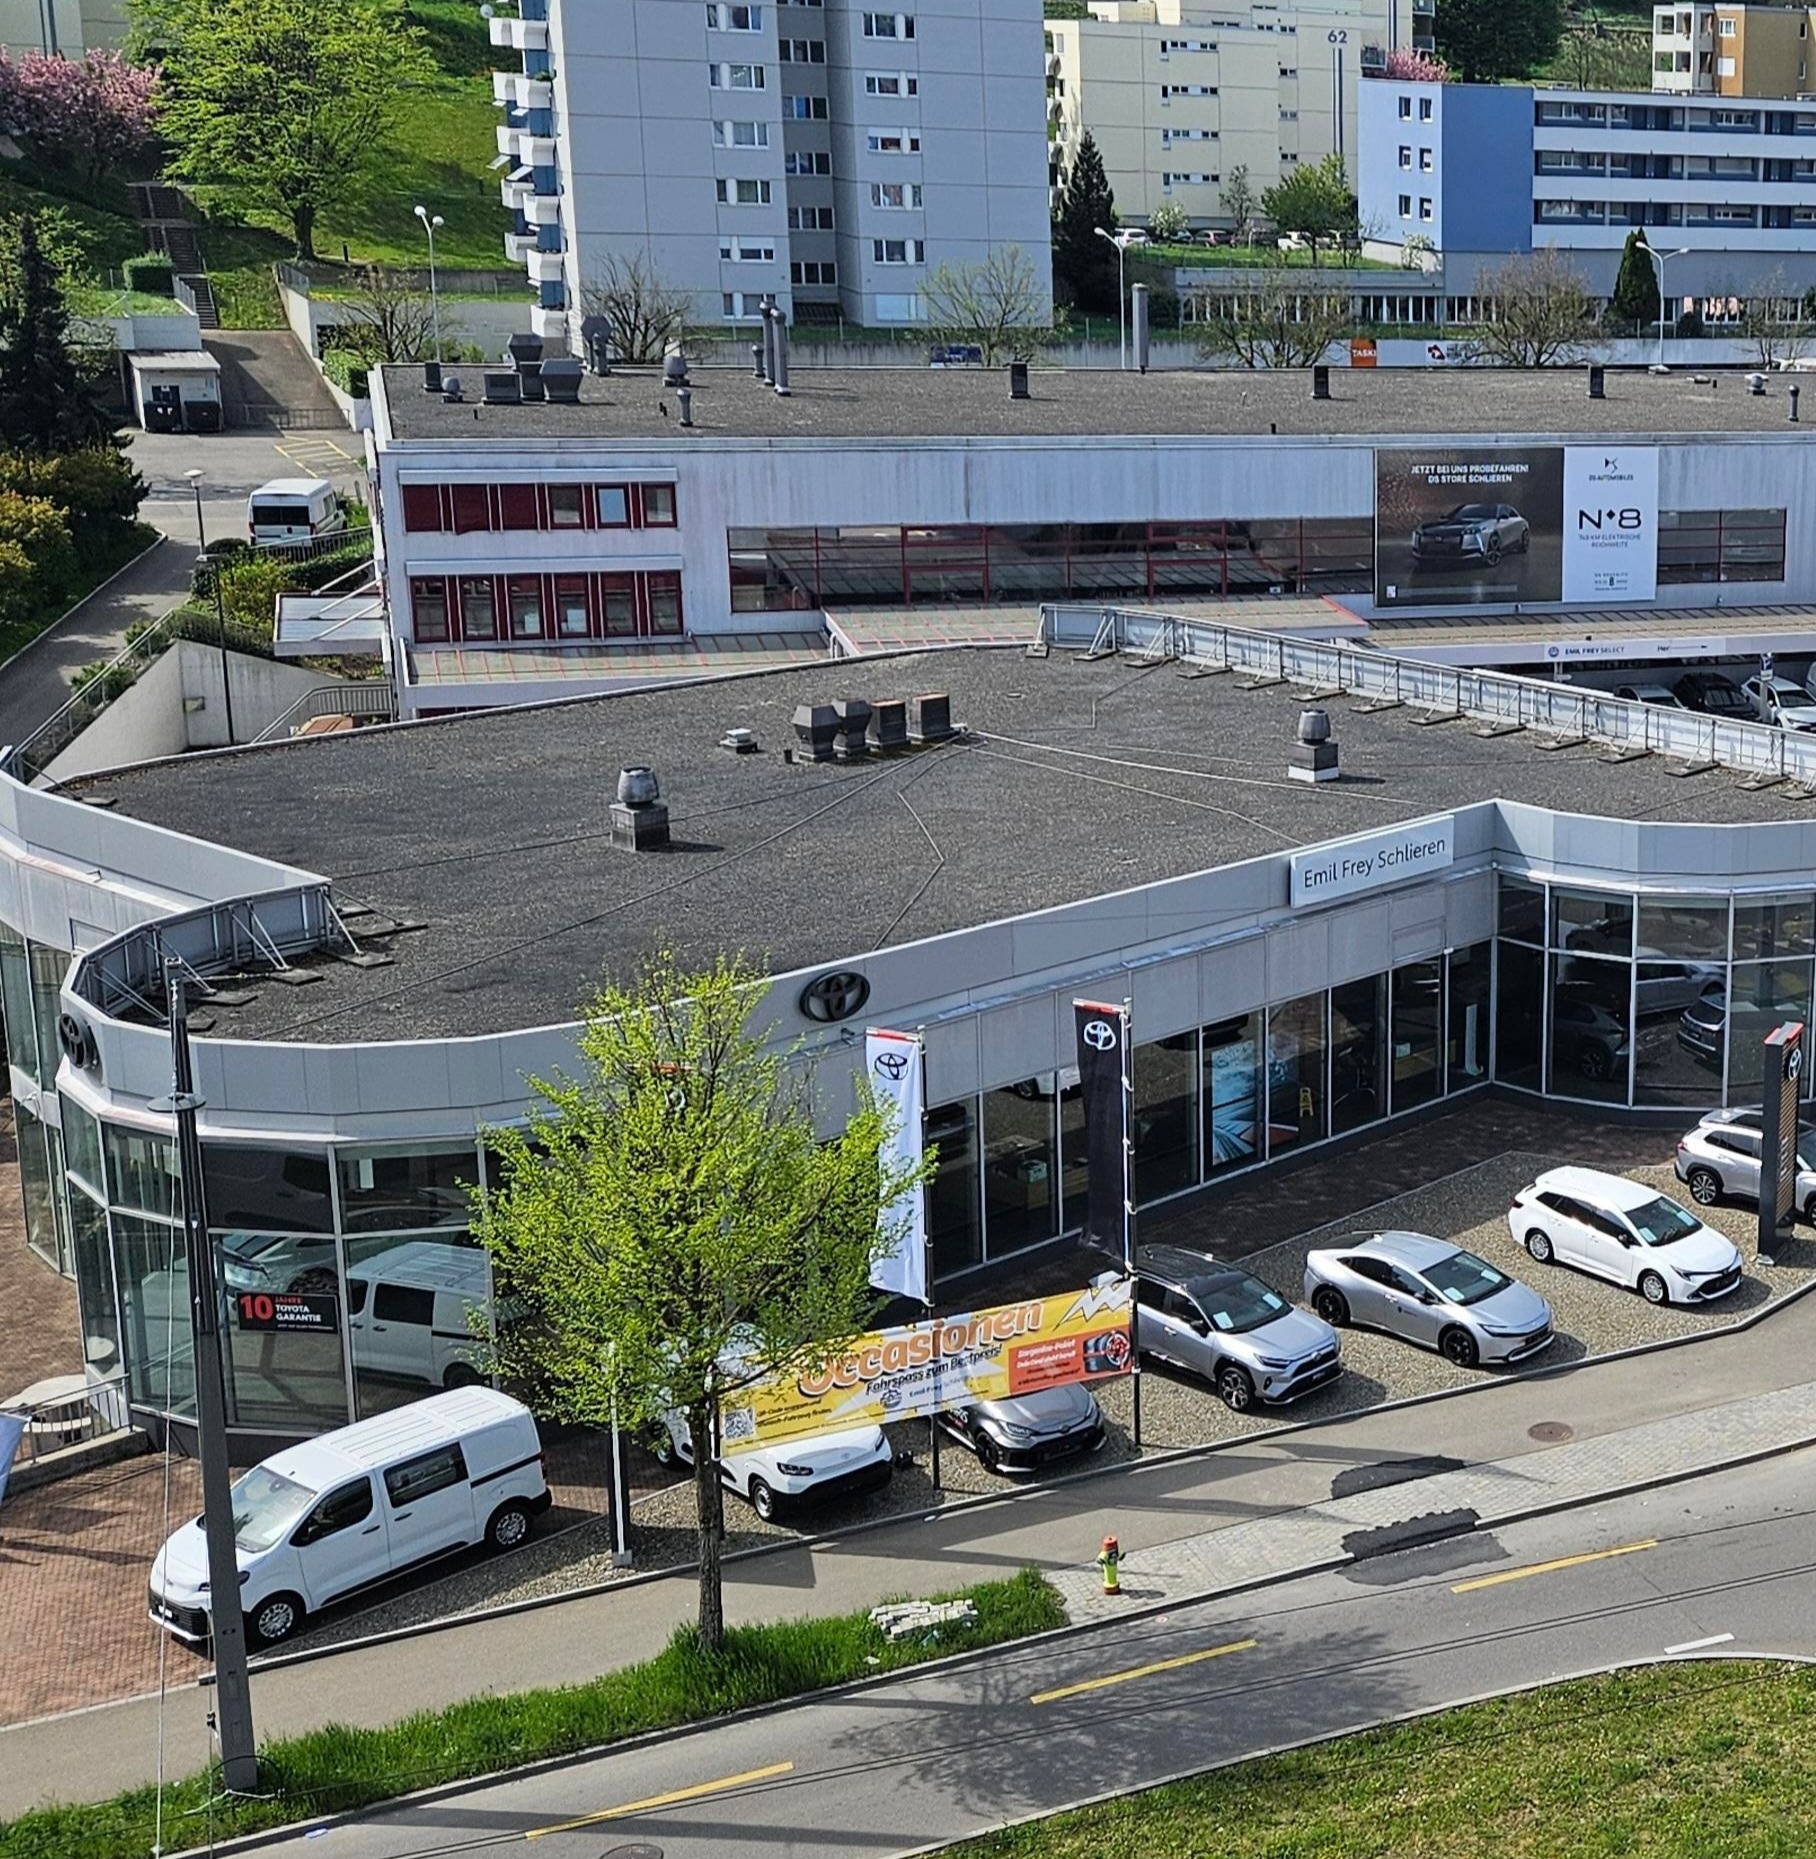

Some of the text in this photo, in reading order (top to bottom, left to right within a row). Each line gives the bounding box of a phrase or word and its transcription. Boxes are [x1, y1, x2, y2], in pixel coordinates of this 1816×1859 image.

[1328, 29, 1347, 43] 62
[1352, 349, 1377, 358] TASKI
[1411, 464, 1529, 474] JETZT BEI UNS PROBEFAHREN!
[1428, 474, 1513, 483] DS STORE SCHLIEREN
[1582, 647, 1599, 655] FREY
[1304, 839, 1445, 888] Emil Frey Schlieren
[241, 1295, 273, 1320] 10
[275, 1305, 310, 1313] TOYOTA
[276, 1313, 321, 1322] GARANTIE
[866, 1370, 924, 1396] Fahrspass
[925, 1363, 949, 1379] zum
